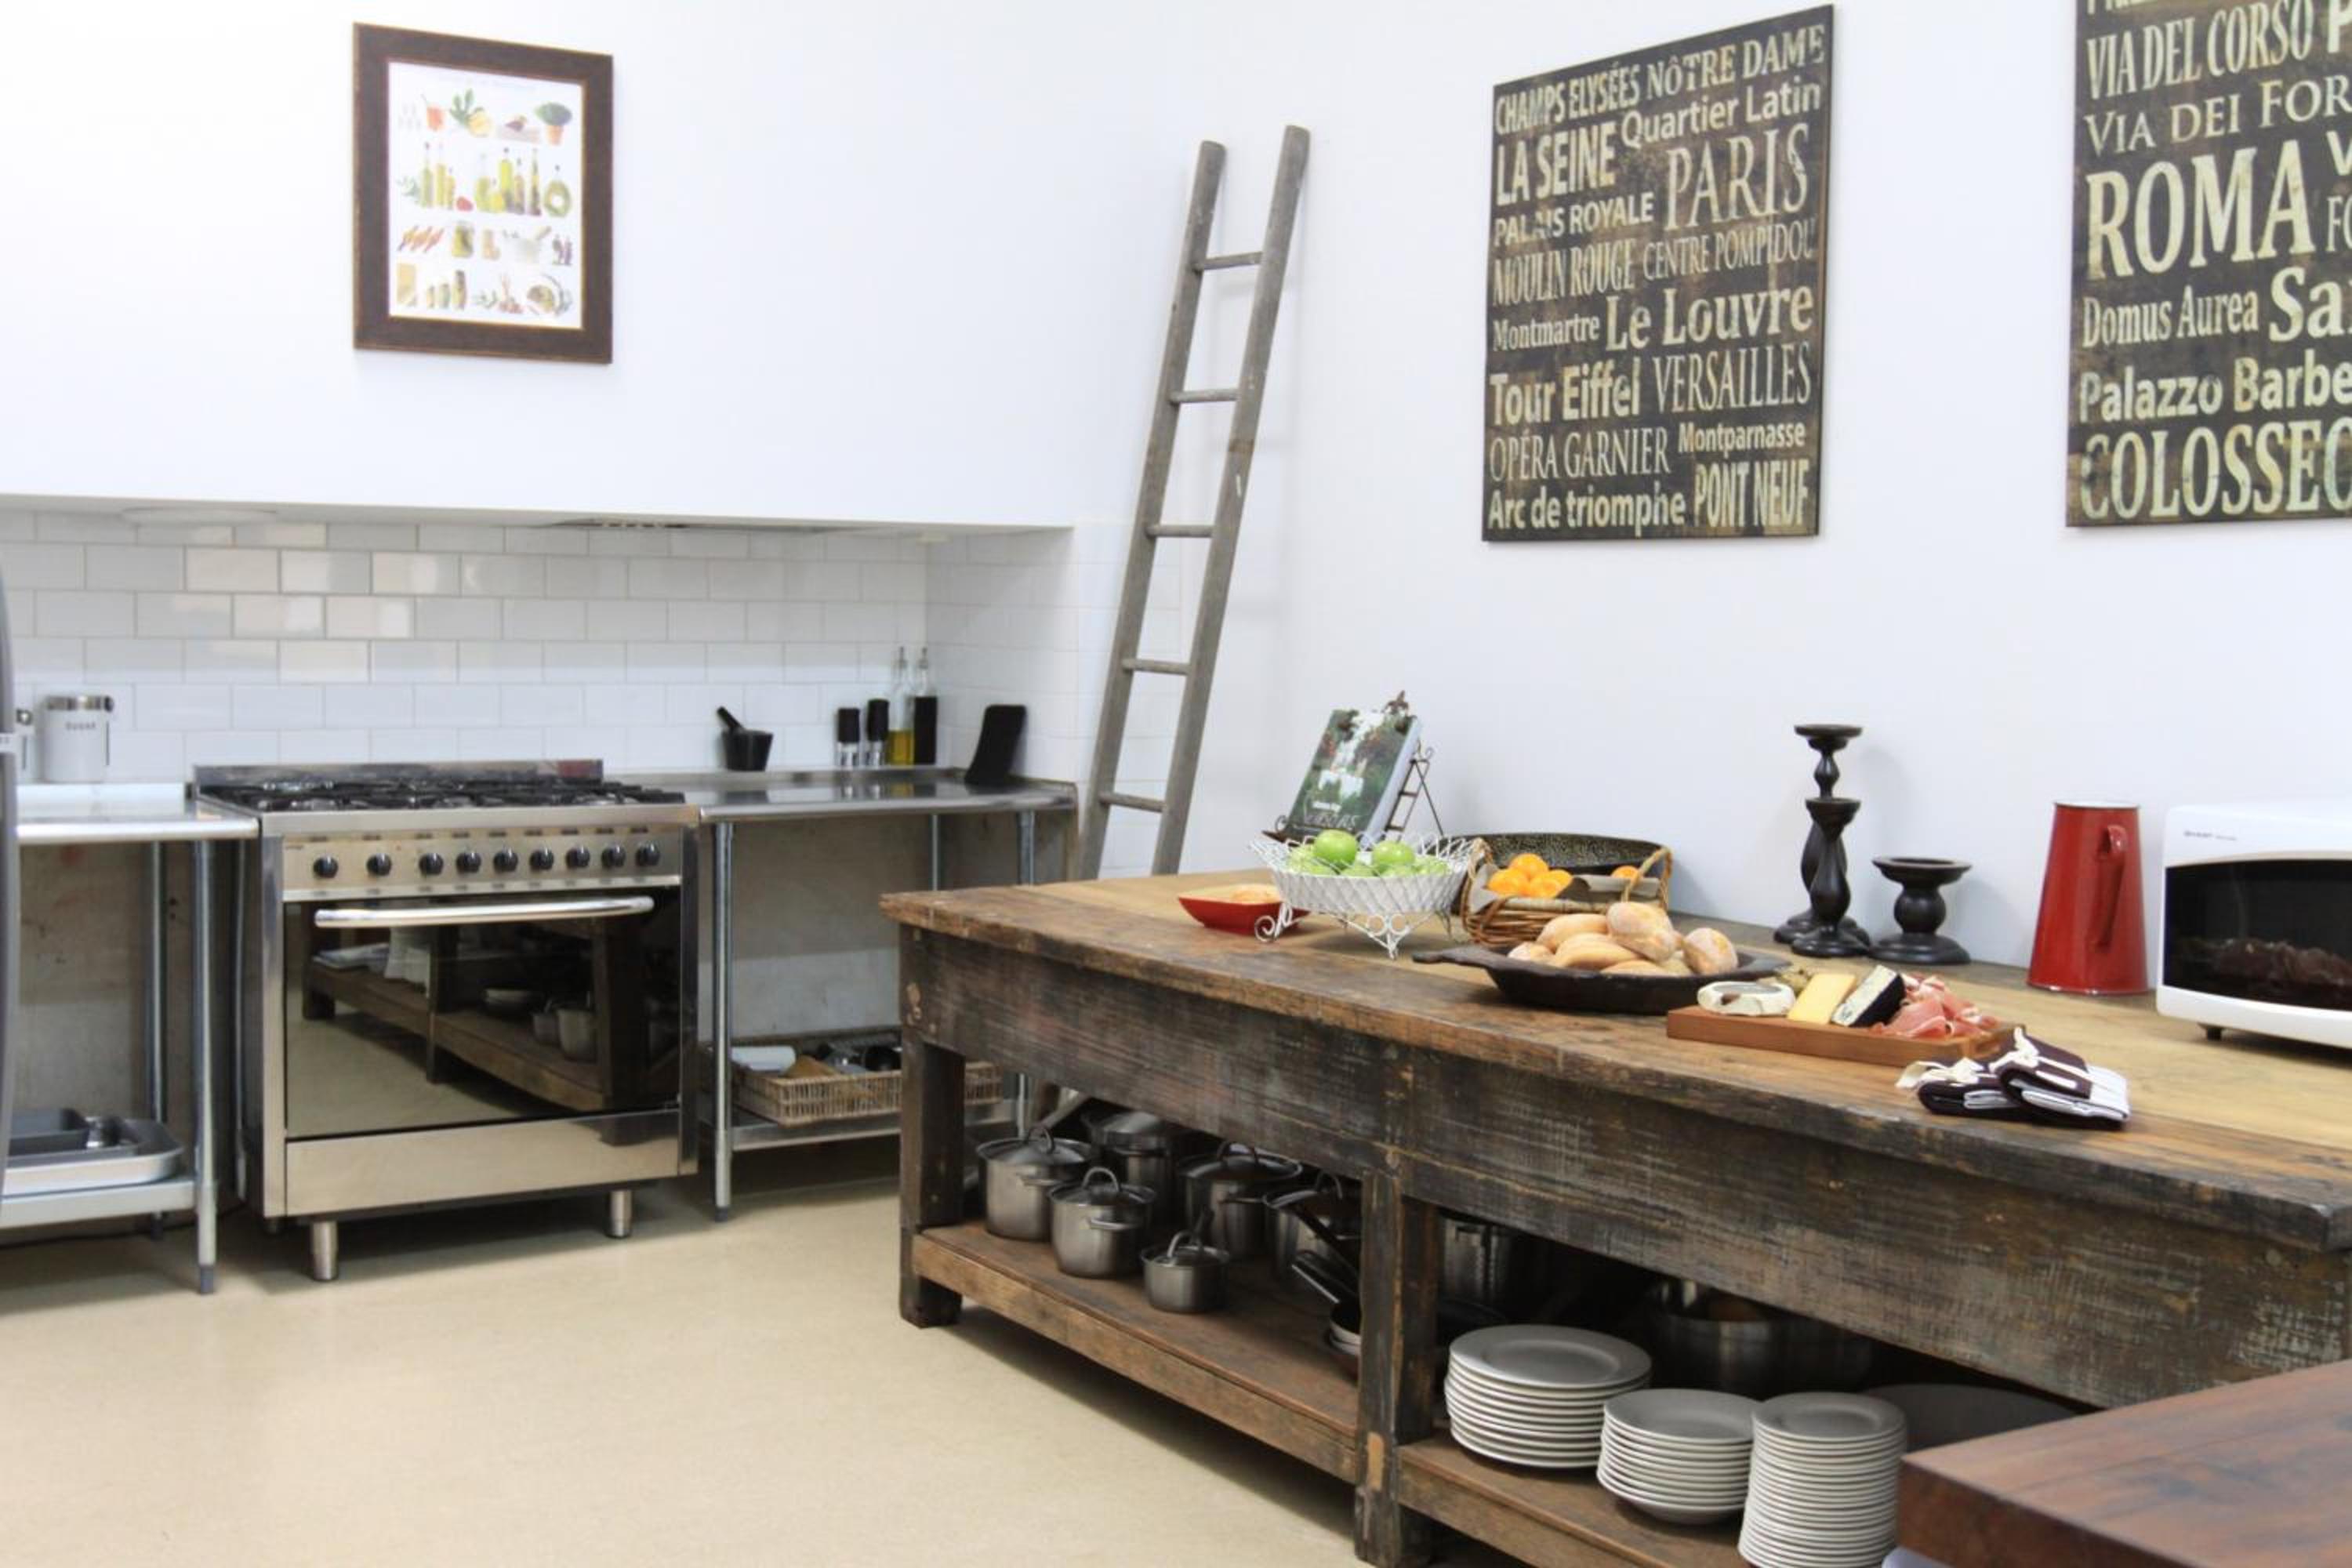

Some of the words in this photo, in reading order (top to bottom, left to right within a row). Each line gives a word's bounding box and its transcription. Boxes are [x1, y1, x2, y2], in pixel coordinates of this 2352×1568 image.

[1647, 44, 1737, 100] NÔTRE
[1743, 24, 1825, 78] DAME
[2086, 31, 2137, 100] VIA
[2143, 17, 2201, 90] DEL
[2207, 0, 2313, 77] CORSO
[1495, 82, 1566, 136] CHAMPS
[1569, 61, 1641, 120] ELYSÉES
[1621, 93, 1739, 149] Quartier
[1745, 74, 1820, 123] Latin
[2084, 111, 2156, 157] VIA
[2170, 93, 2241, 144] DEI
[1497, 141, 1530, 205] LA
[1536, 122, 1617, 199] SEINE
[1664, 123, 1809, 231] PARIS
[1570, 191, 1654, 234] ROYALE
[2085, 139, 2317, 281] ROMA
[1493, 249, 1566, 307] MOULIN
[1570, 238, 1636, 296] ROUGE
[1643, 233, 1709, 281] CENTRE
[1715, 216, 1817, 270] POMPIDOU
[1493, 314, 1601, 352] Montmartre
[1605, 296, 1651, 351] Le
[1662, 285, 1814, 346] Louvre
[2082, 296, 2172, 348] Domus
[2176, 284, 2259, 339] Aurea
[2269, 267, 2352, 342] Sa
[1490, 373, 1555, 426] Tour
[1563, 357, 1640, 420] Eiffel
[1653, 341, 1811, 414] VERSAILLES
[2079, 365, 2223, 423] Palazzo
[1490, 428, 1564, 483] OPÉRA
[1563, 426, 1671, 480] GARNIER
[1678, 421, 1806, 459] Montparnasse
[1488, 490, 1525, 530] Arc
[1530, 485, 1560, 528] de
[1566, 481, 1686, 537] triomphe
[1693, 461, 1749, 528] PONT
[1754, 459, 1809, 527] NEUF
